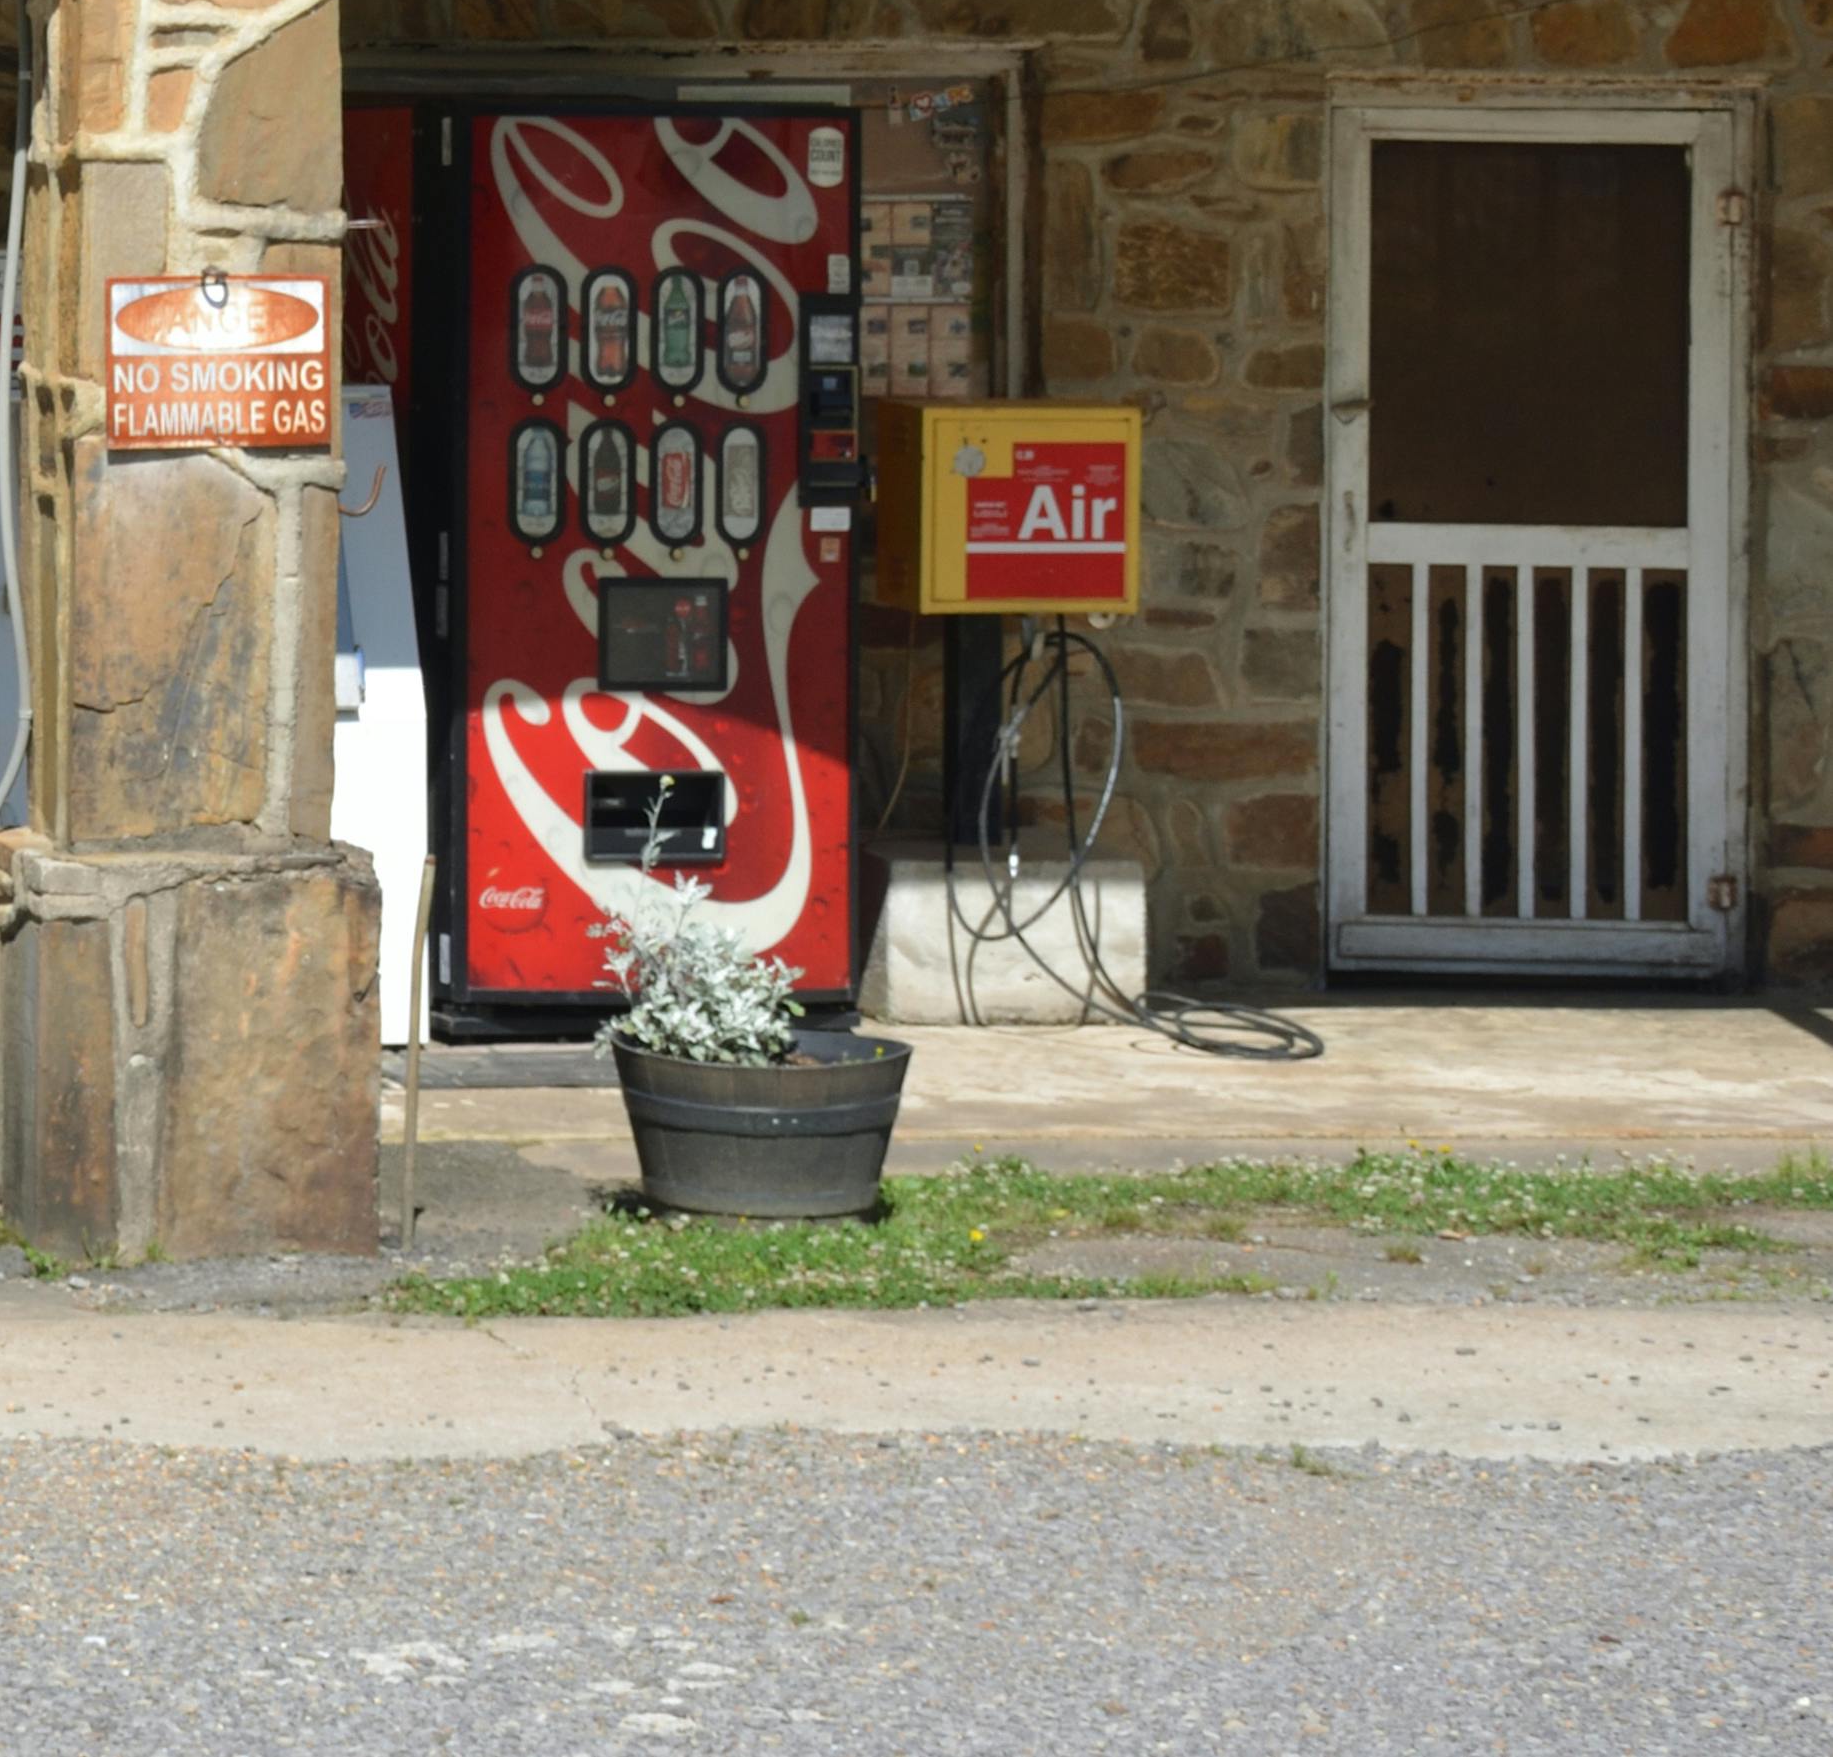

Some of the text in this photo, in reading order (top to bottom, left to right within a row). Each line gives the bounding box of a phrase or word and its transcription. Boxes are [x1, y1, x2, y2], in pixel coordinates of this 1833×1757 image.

[113, 359, 325, 394] NO SMOKING
[113, 399, 327, 437] FLAMMABLE GAS
[1016, 483, 1118, 541] Air
[478, 884, 545, 910] Coca-Cola
